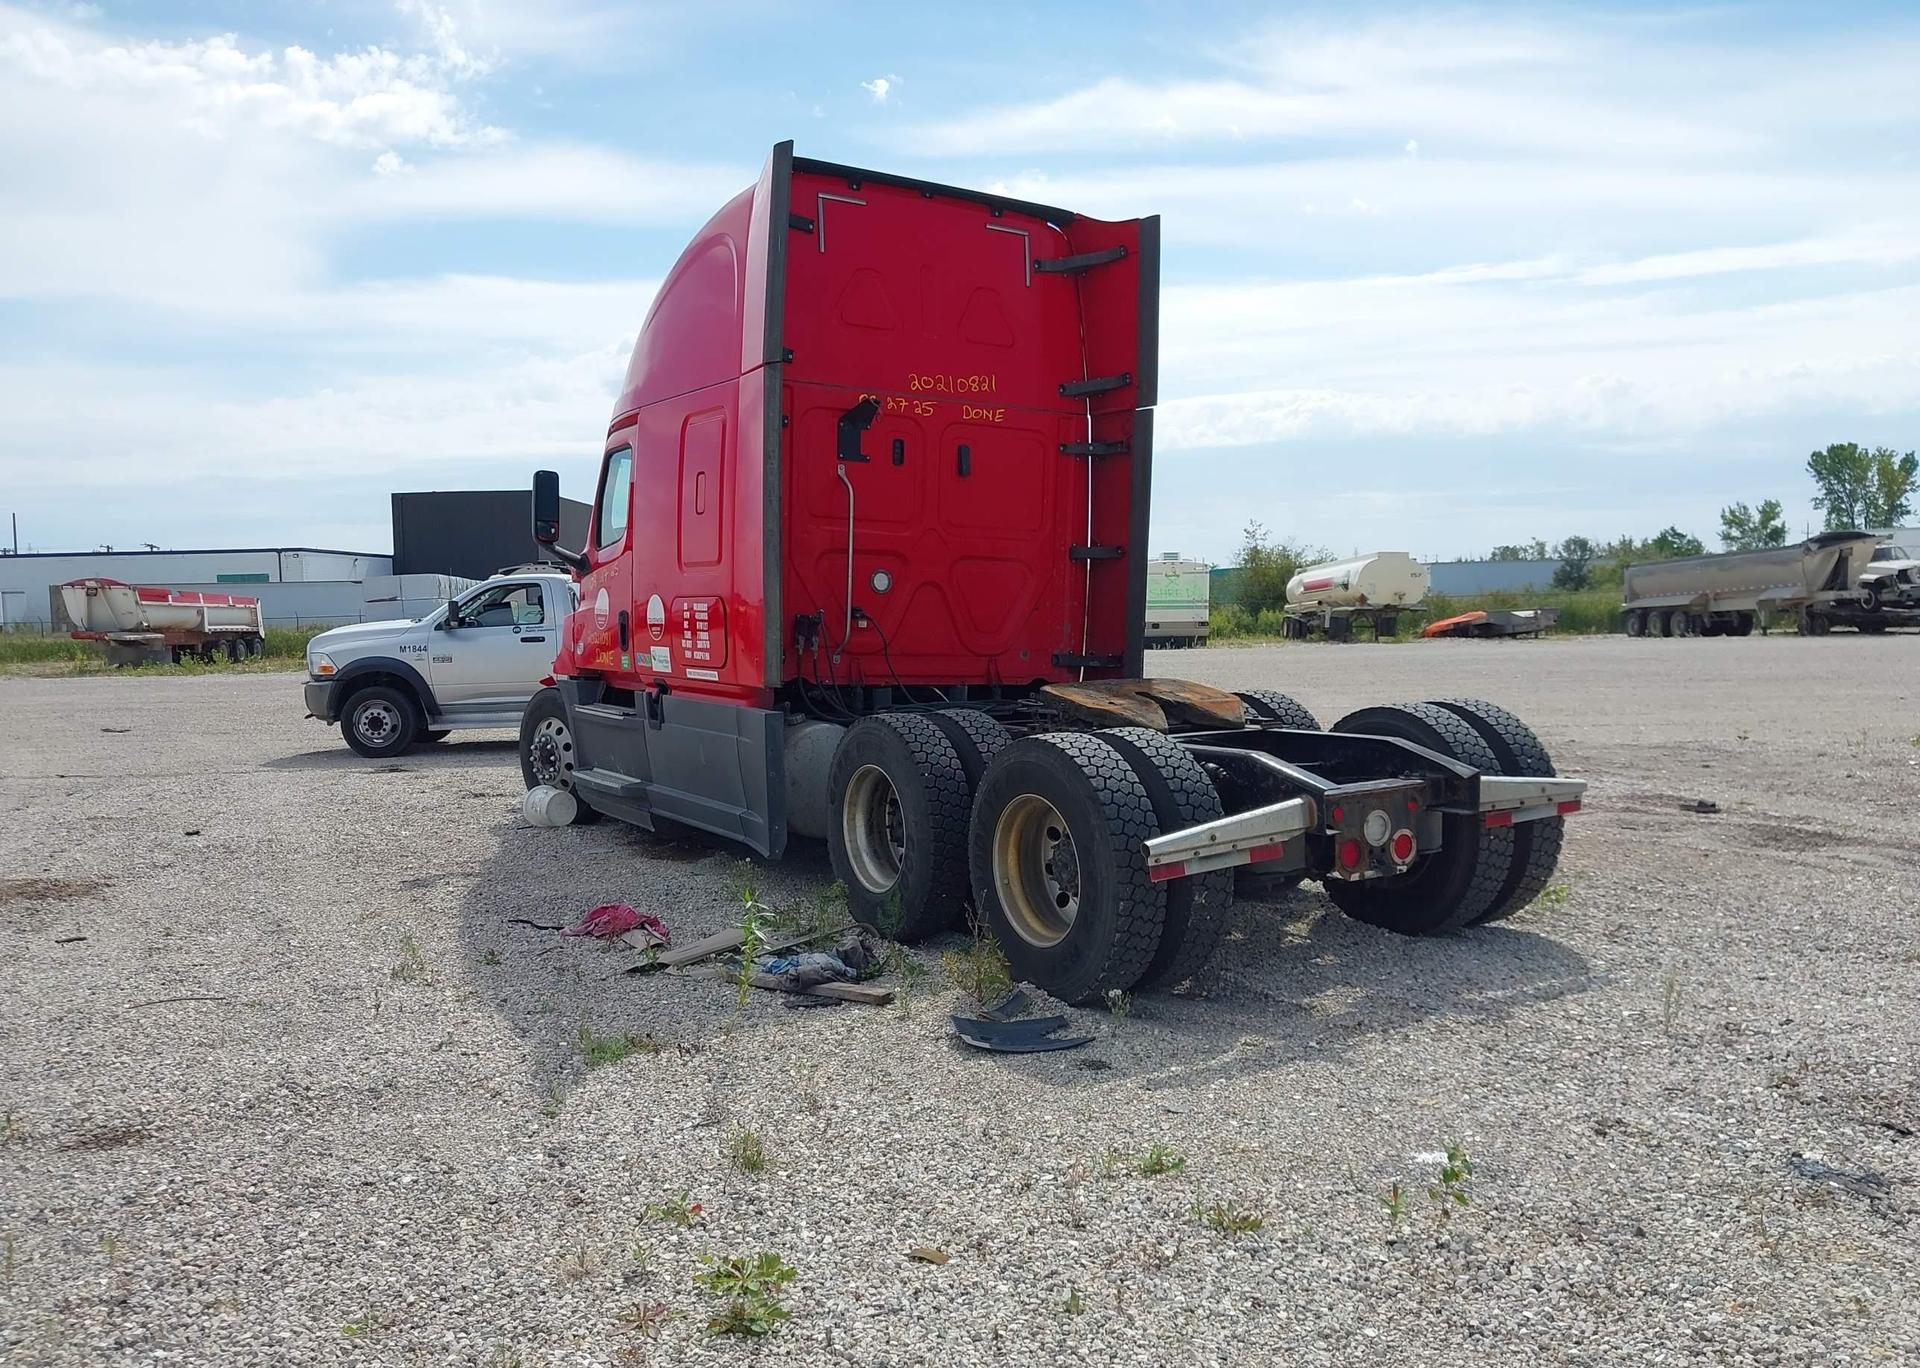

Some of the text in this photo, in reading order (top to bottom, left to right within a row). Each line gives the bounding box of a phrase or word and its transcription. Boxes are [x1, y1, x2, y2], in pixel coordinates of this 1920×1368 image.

[908, 373, 997, 393] 20210821
[962, 405, 1005, 422] DONE
[399, 645, 427, 653] M1844
